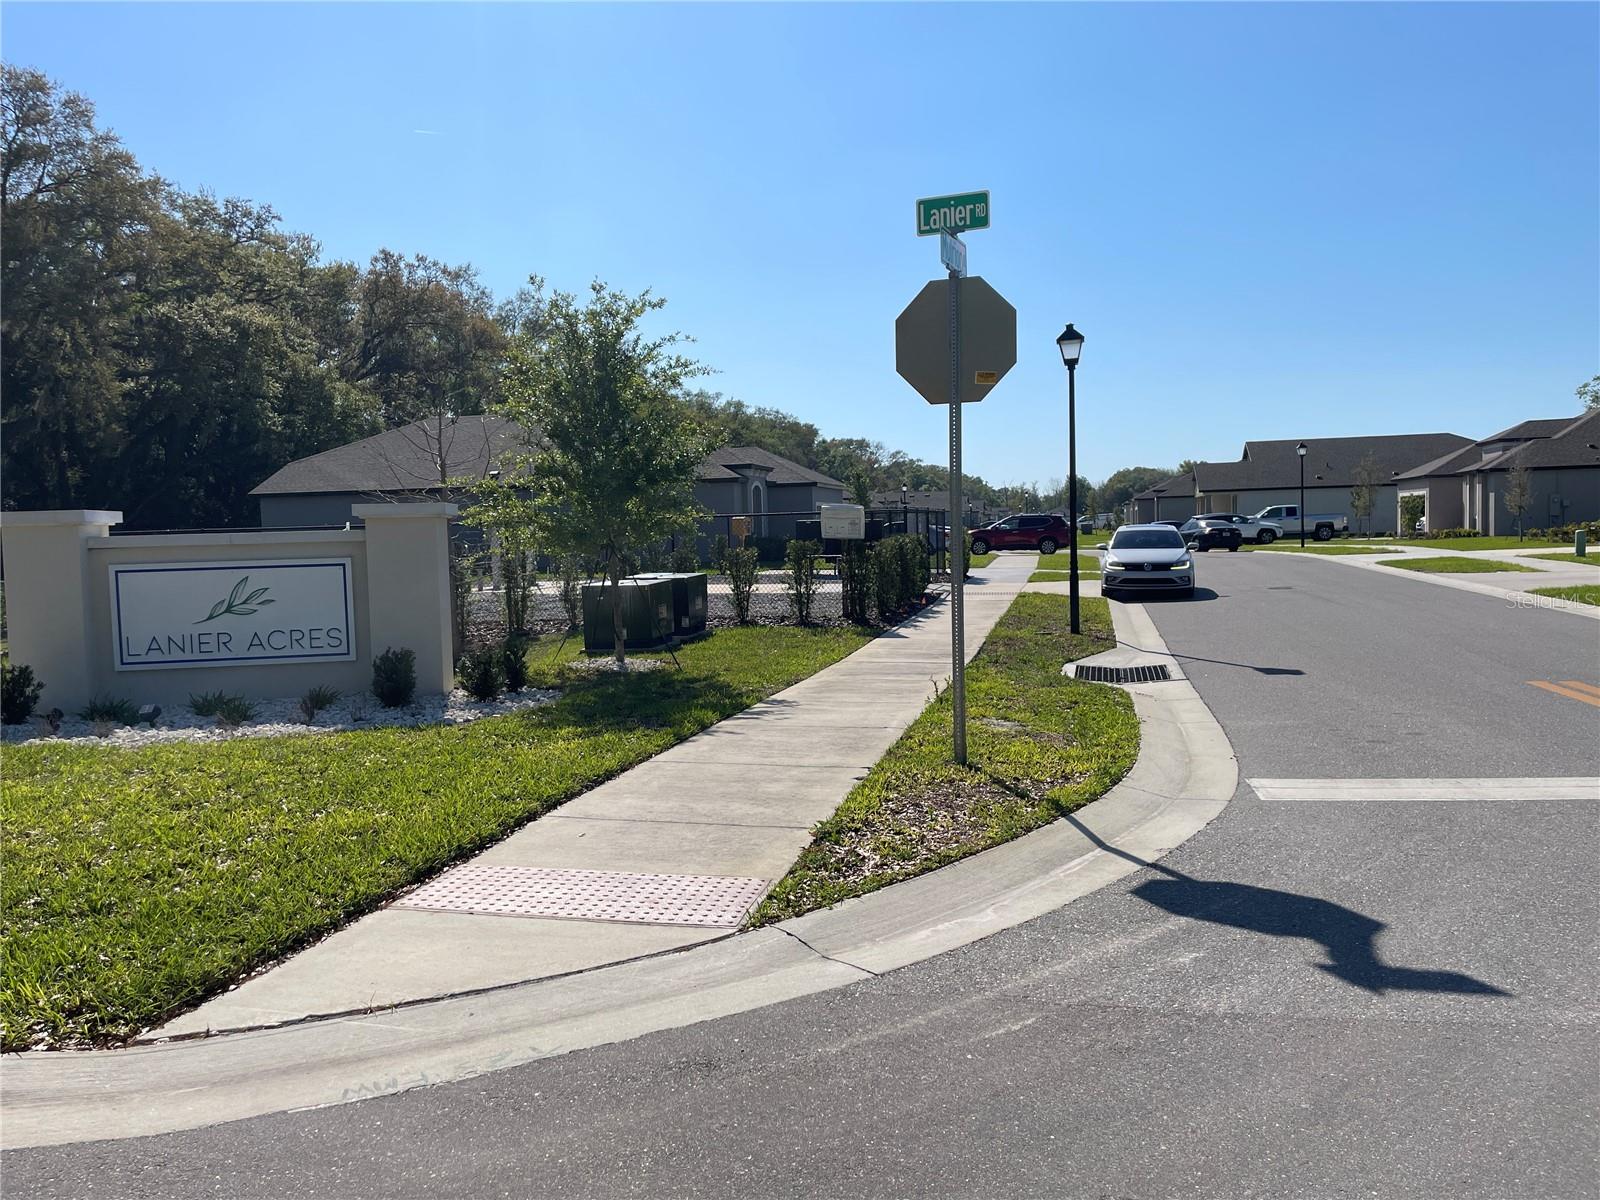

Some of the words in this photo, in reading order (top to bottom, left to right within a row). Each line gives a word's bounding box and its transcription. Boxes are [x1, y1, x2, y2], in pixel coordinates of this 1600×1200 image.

[920, 200, 974, 231] Lanier
[975, 203, 987, 217] RD
[126, 631, 233, 657] LANIER
[247, 627, 344, 651] ACRES
